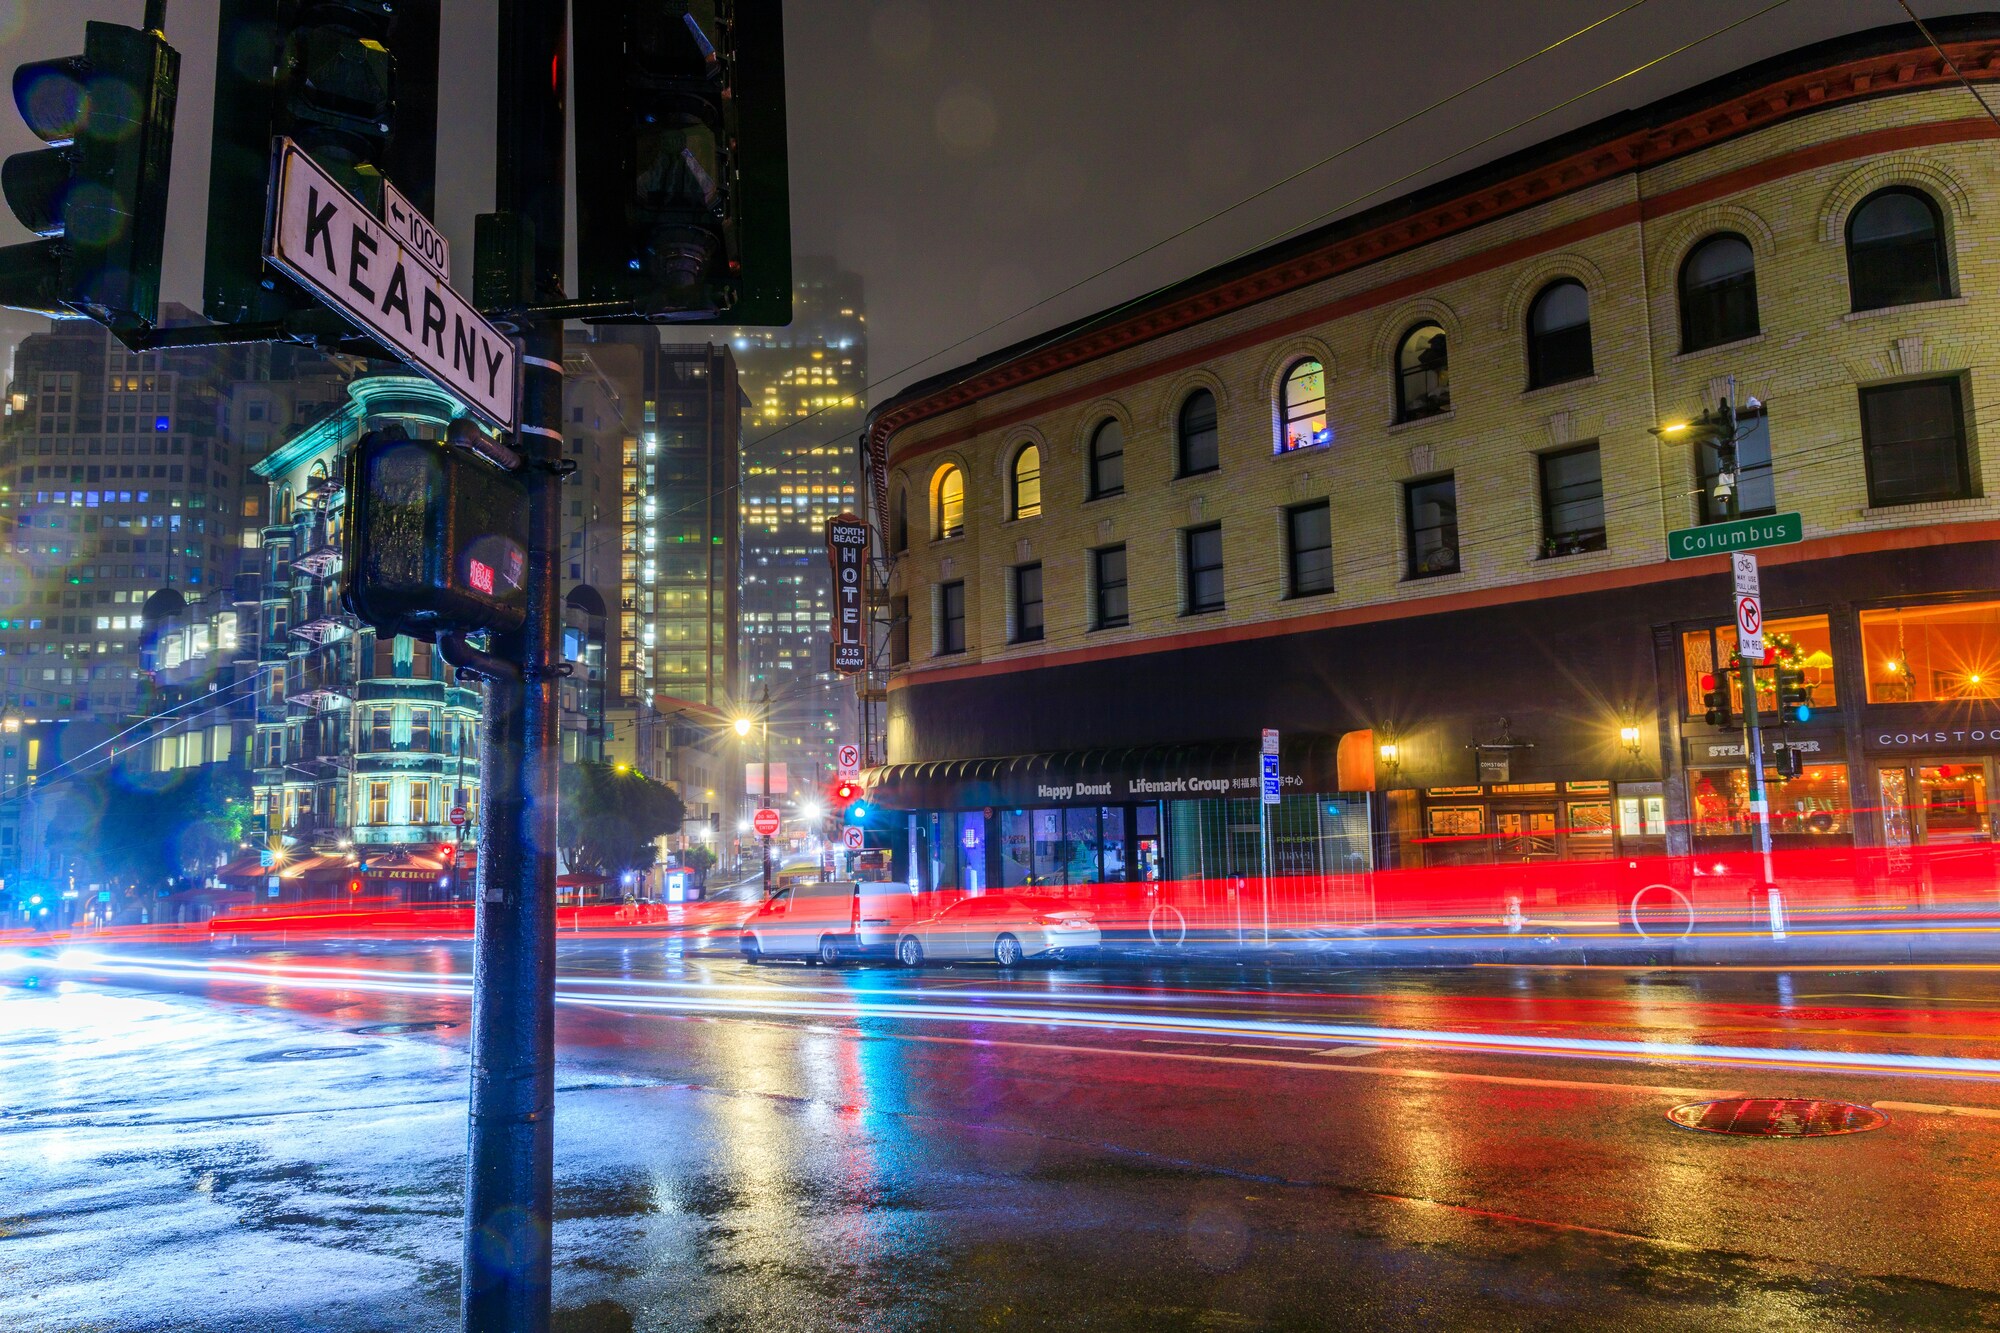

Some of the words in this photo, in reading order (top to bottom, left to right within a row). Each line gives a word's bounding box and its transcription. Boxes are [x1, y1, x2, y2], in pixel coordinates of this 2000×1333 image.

[408, 213, 444, 269] 1000
[305, 185, 504, 398] KEARNY
[833, 526, 865, 536] NORTH
[1683, 525, 1786, 550] Columbus
[833, 535, 865, 545] BEACH
[1737, 582, 1747, 590] FULL
[1742, 639, 1750, 649] ON
[1752, 640, 1762, 651] RED
[836, 658, 864, 666] KEARNY
[1038, 784, 1073, 799] Happy
[1076, 782, 1111, 796] Donut
[1129, 778, 1185, 793] Lifemark
[1188, 777, 1229, 793] Group
